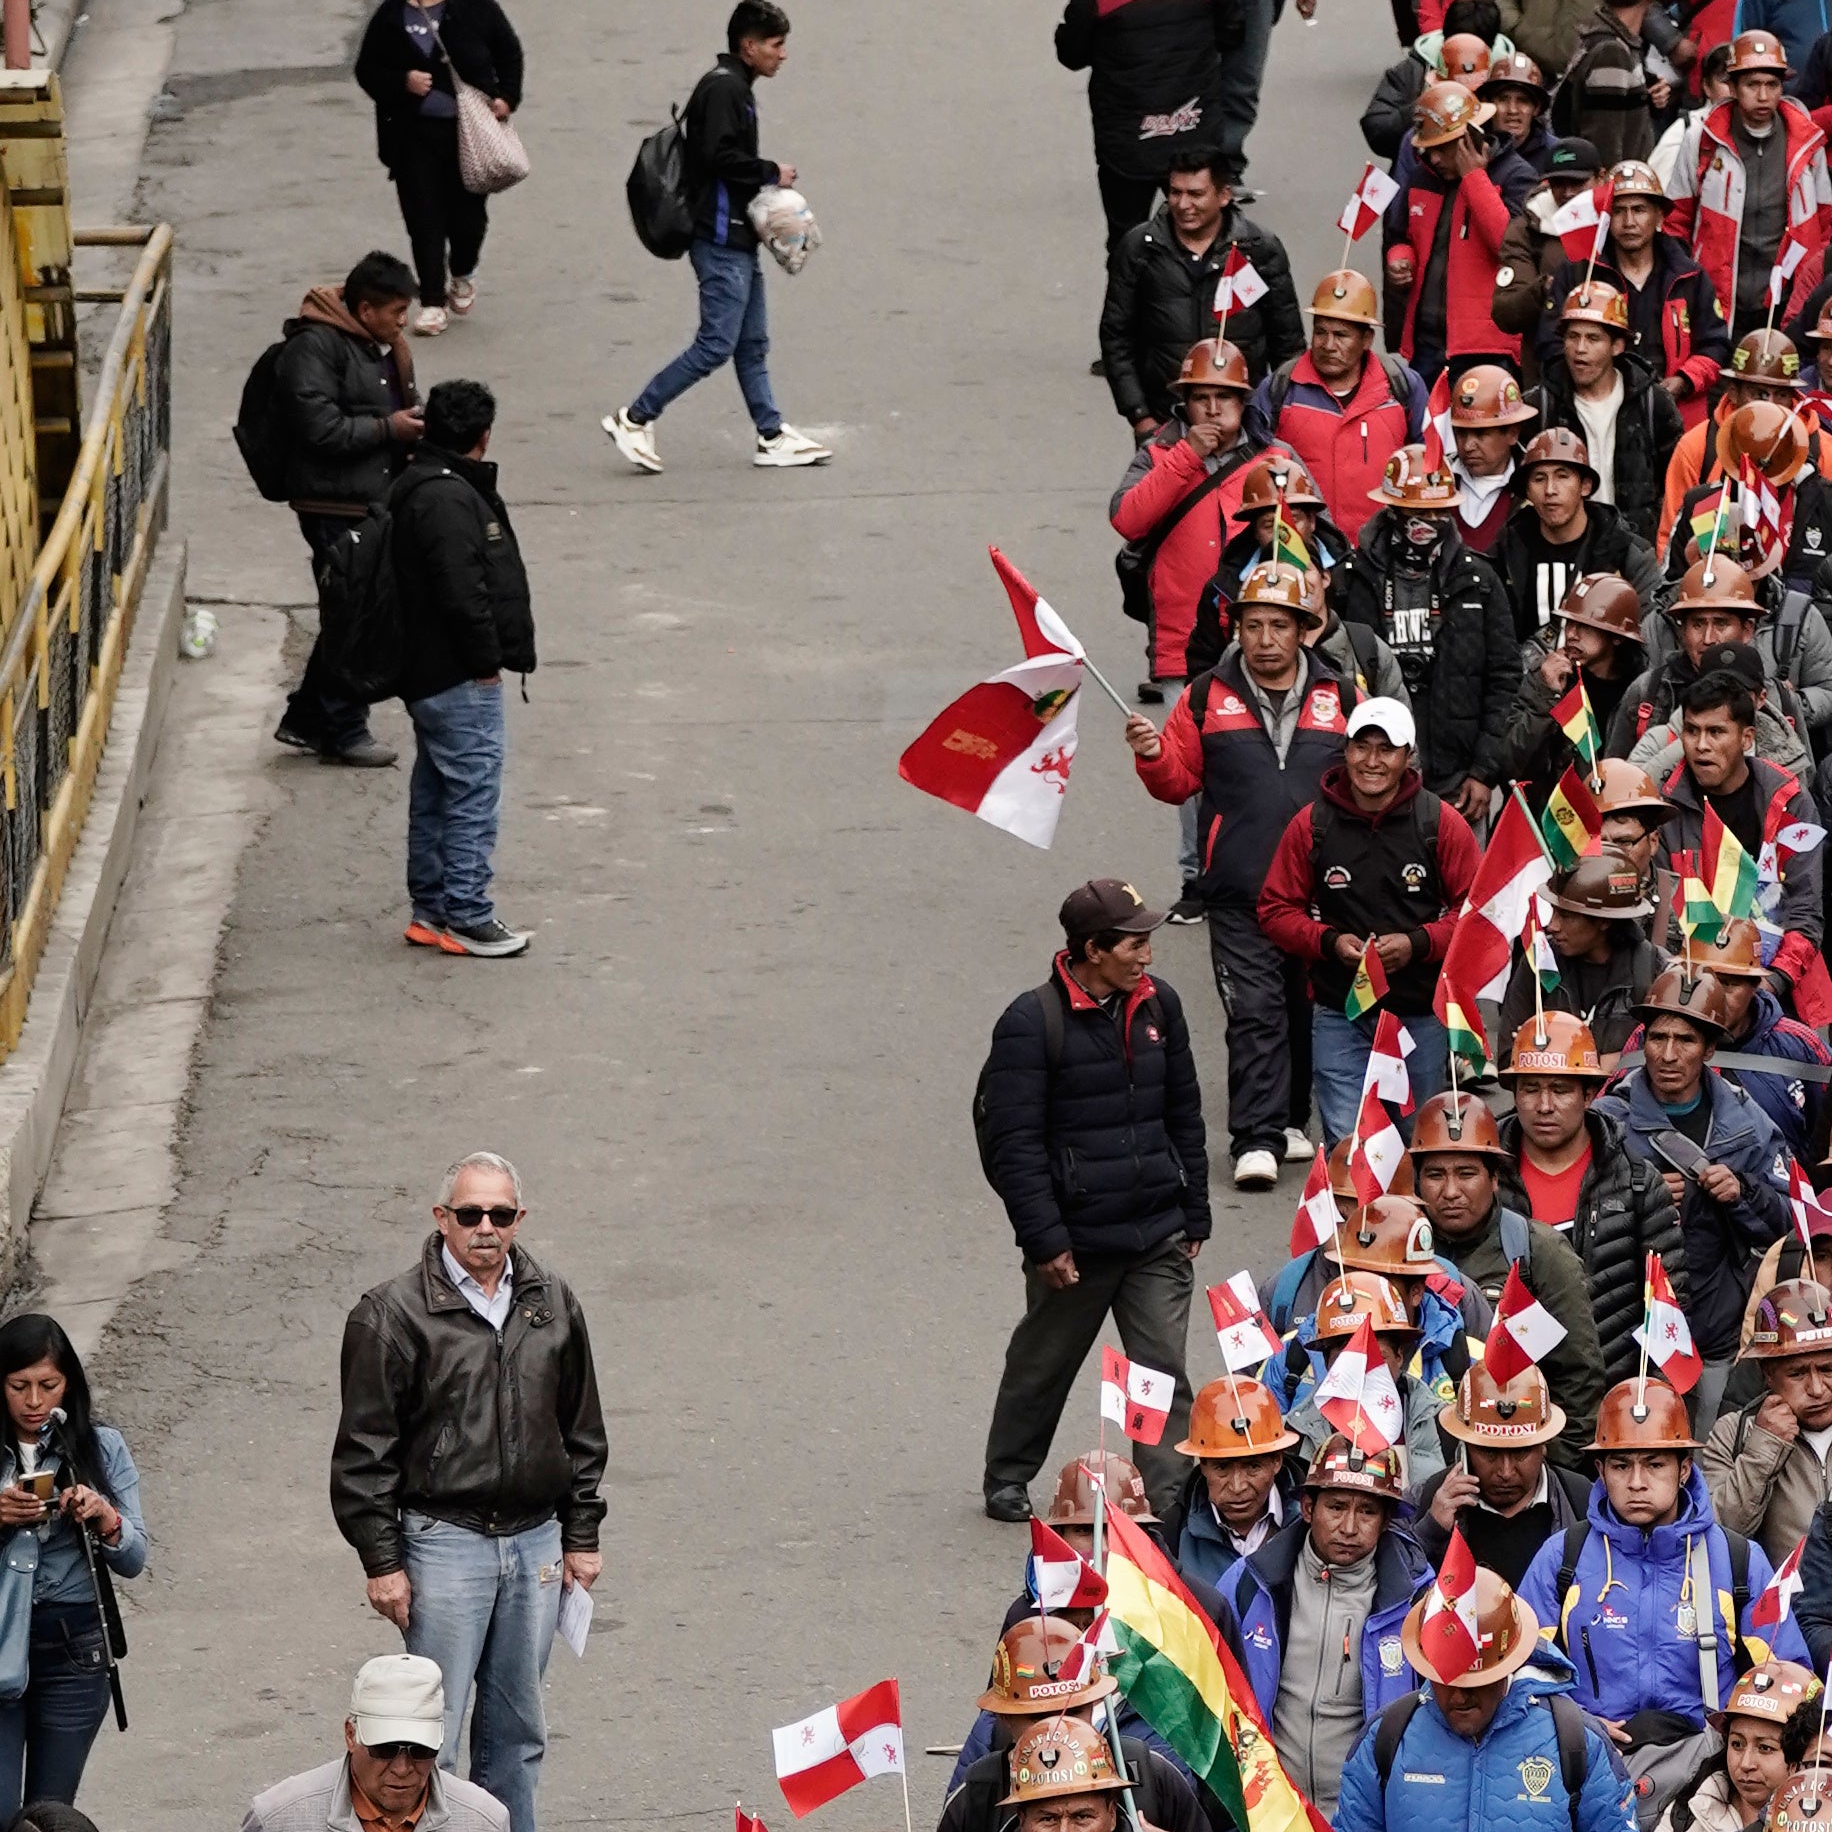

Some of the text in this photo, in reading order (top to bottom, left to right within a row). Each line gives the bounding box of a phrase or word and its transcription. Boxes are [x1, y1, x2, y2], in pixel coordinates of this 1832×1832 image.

[1518, 1051, 1567, 1068] POTOSI
[1474, 1421, 1537, 1439] POTOSI
[1333, 1470, 1374, 1487] POTOSI
[1030, 1680, 1082, 1700] POTOSI
[1738, 1695, 1779, 1712] POTOSI
[1019, 1729, 1086, 1767] UNIFICADA
[1031, 1767, 1074, 1786] POTOSI
